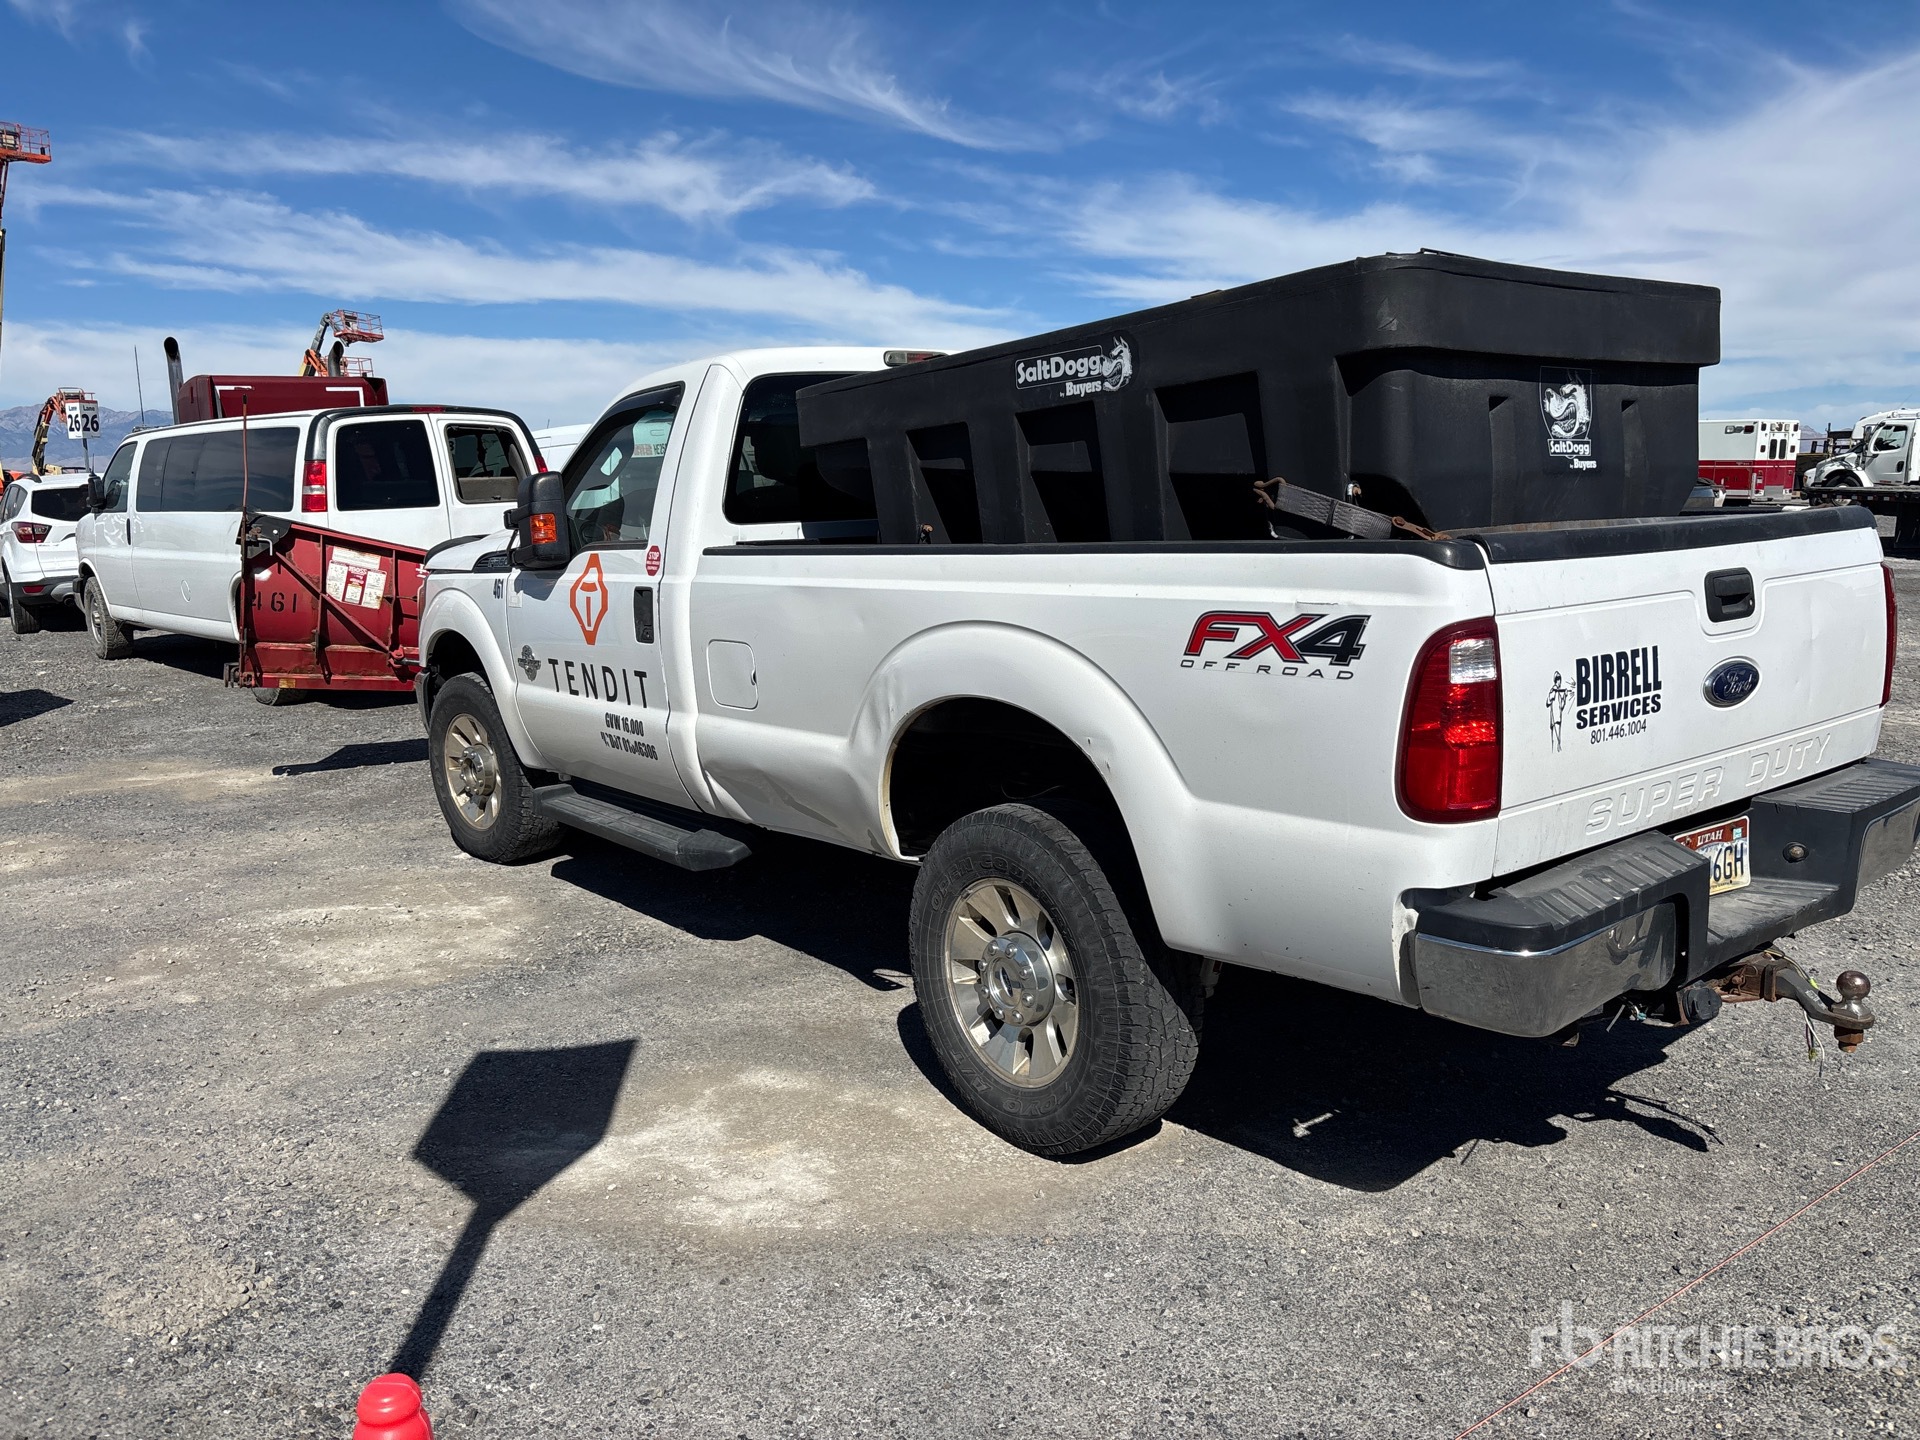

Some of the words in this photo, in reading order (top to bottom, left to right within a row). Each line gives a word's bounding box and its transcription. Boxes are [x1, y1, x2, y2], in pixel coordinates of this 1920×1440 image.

[1017, 355, 1101, 384] SaltDogg
[1065, 381, 1102, 397] Buyers
[68, 414, 81, 432] 26
[82, 414, 100, 432] 26
[1550, 440, 1590, 455] SaltDogg
[1573, 459, 1597, 470] Buyers
[648, 551, 660, 560] STOP
[1183, 610, 1372, 667] FX4
[1180, 660, 1240, 671] OFF
[1256, 665, 1354, 680] ROAD
[1575, 645, 1662, 707] BIRRELL
[548, 658, 648, 708] TENDIT
[1576, 693, 1662, 729] SERVICES
[605, 712, 621, 731] GVW
[1590, 718, 1647, 744] 801.446.1004
[1585, 766, 1725, 836] SUPER
[1745, 733, 1831, 787] DUTY
[1696, 829, 1724, 847] UTAH
[1709, 843, 1744, 882] 6GH
